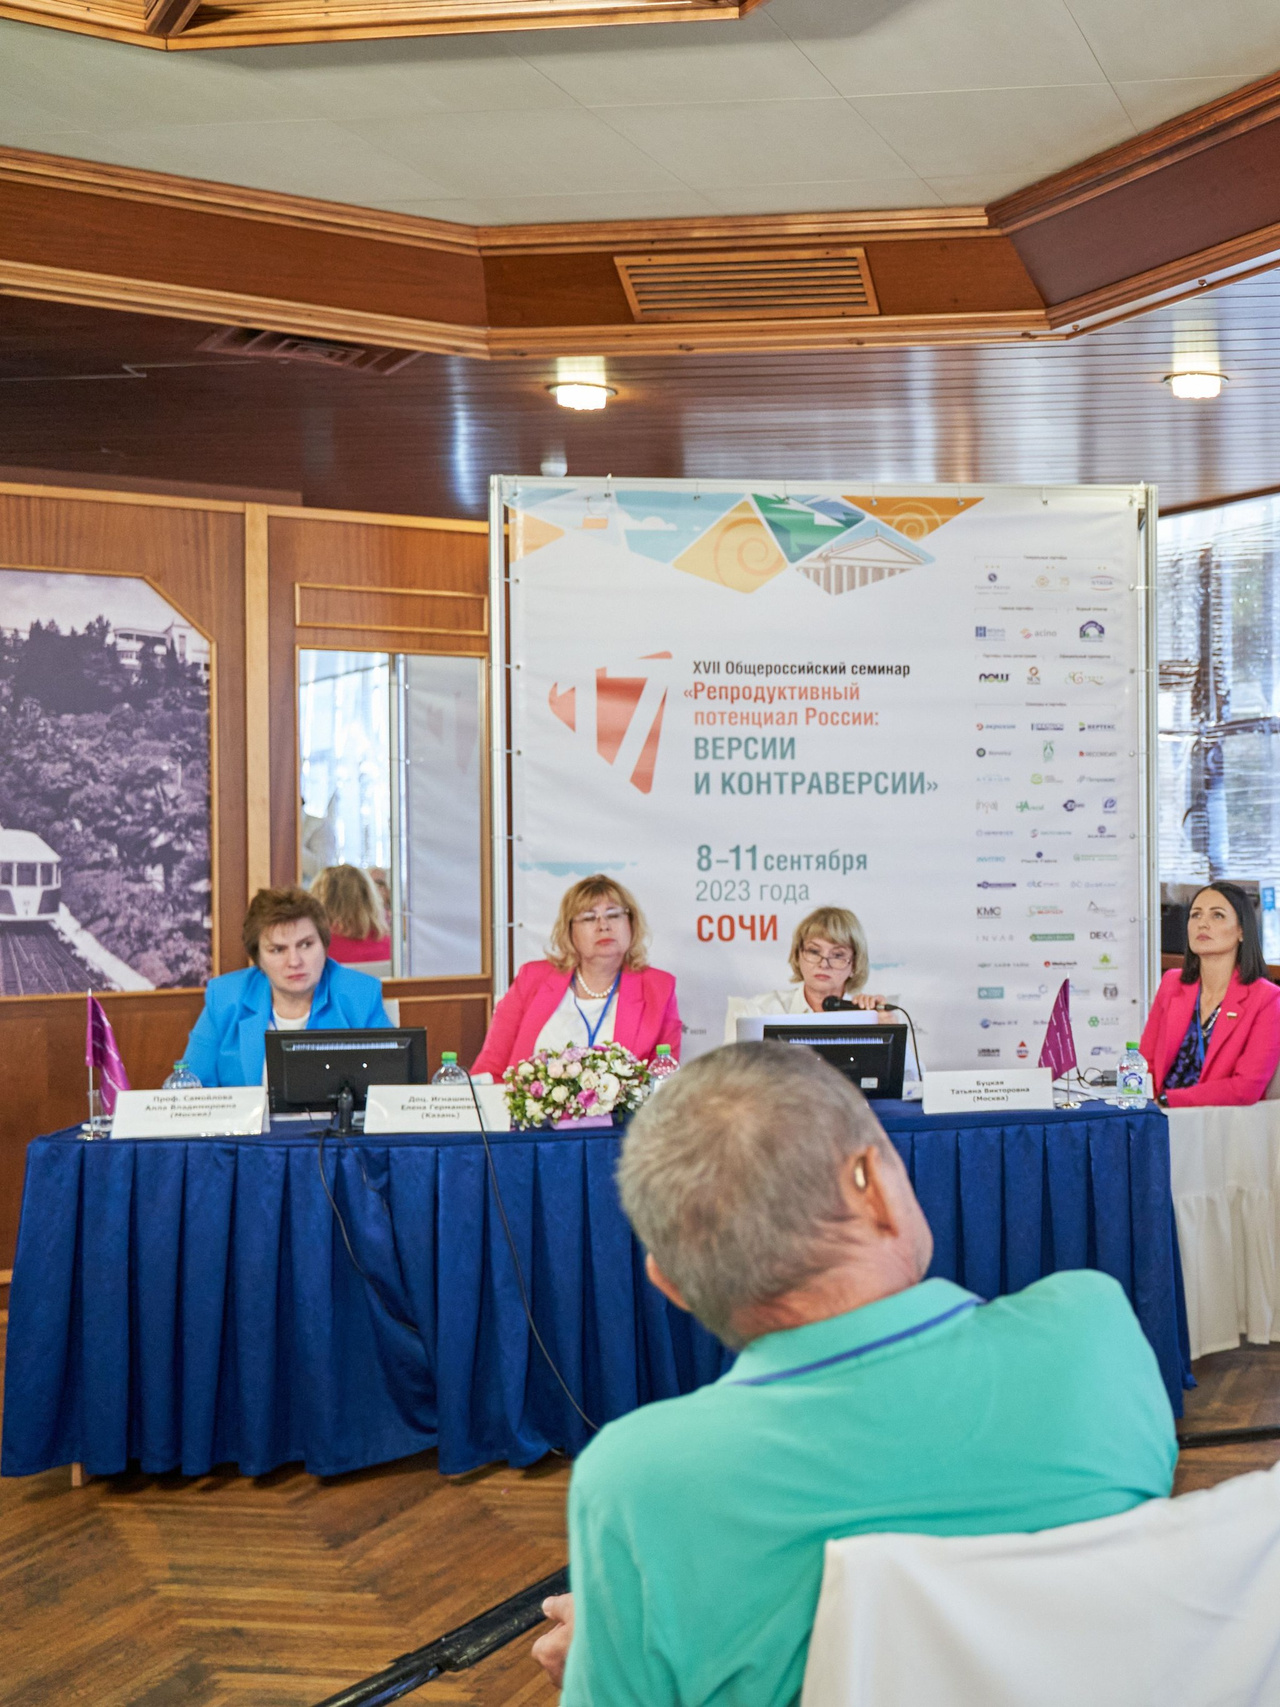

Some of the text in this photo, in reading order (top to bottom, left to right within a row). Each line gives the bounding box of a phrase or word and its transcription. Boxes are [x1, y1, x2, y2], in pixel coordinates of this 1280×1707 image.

[1034, 629, 1058, 637] acino
[692, 661, 911, 678] XVII Общероссийский семинар
[683, 681, 860, 704] «Репродуктивный
[694, 707, 880, 729] потенциал России:
[693, 736, 796, 760] ВЕРСИИ
[693, 771, 939, 796] И КОНТРАВЕРСИИ»
[763, 849, 868, 876] сентября
[695, 879, 810, 905] 2023 года
[696, 914, 778, 943] СОЧИ
[1089, 931, 1115, 940] DEKA
[972, 1095, 1009, 1103] (Москва)
[984, 1086, 1030, 1094] Викторовна
